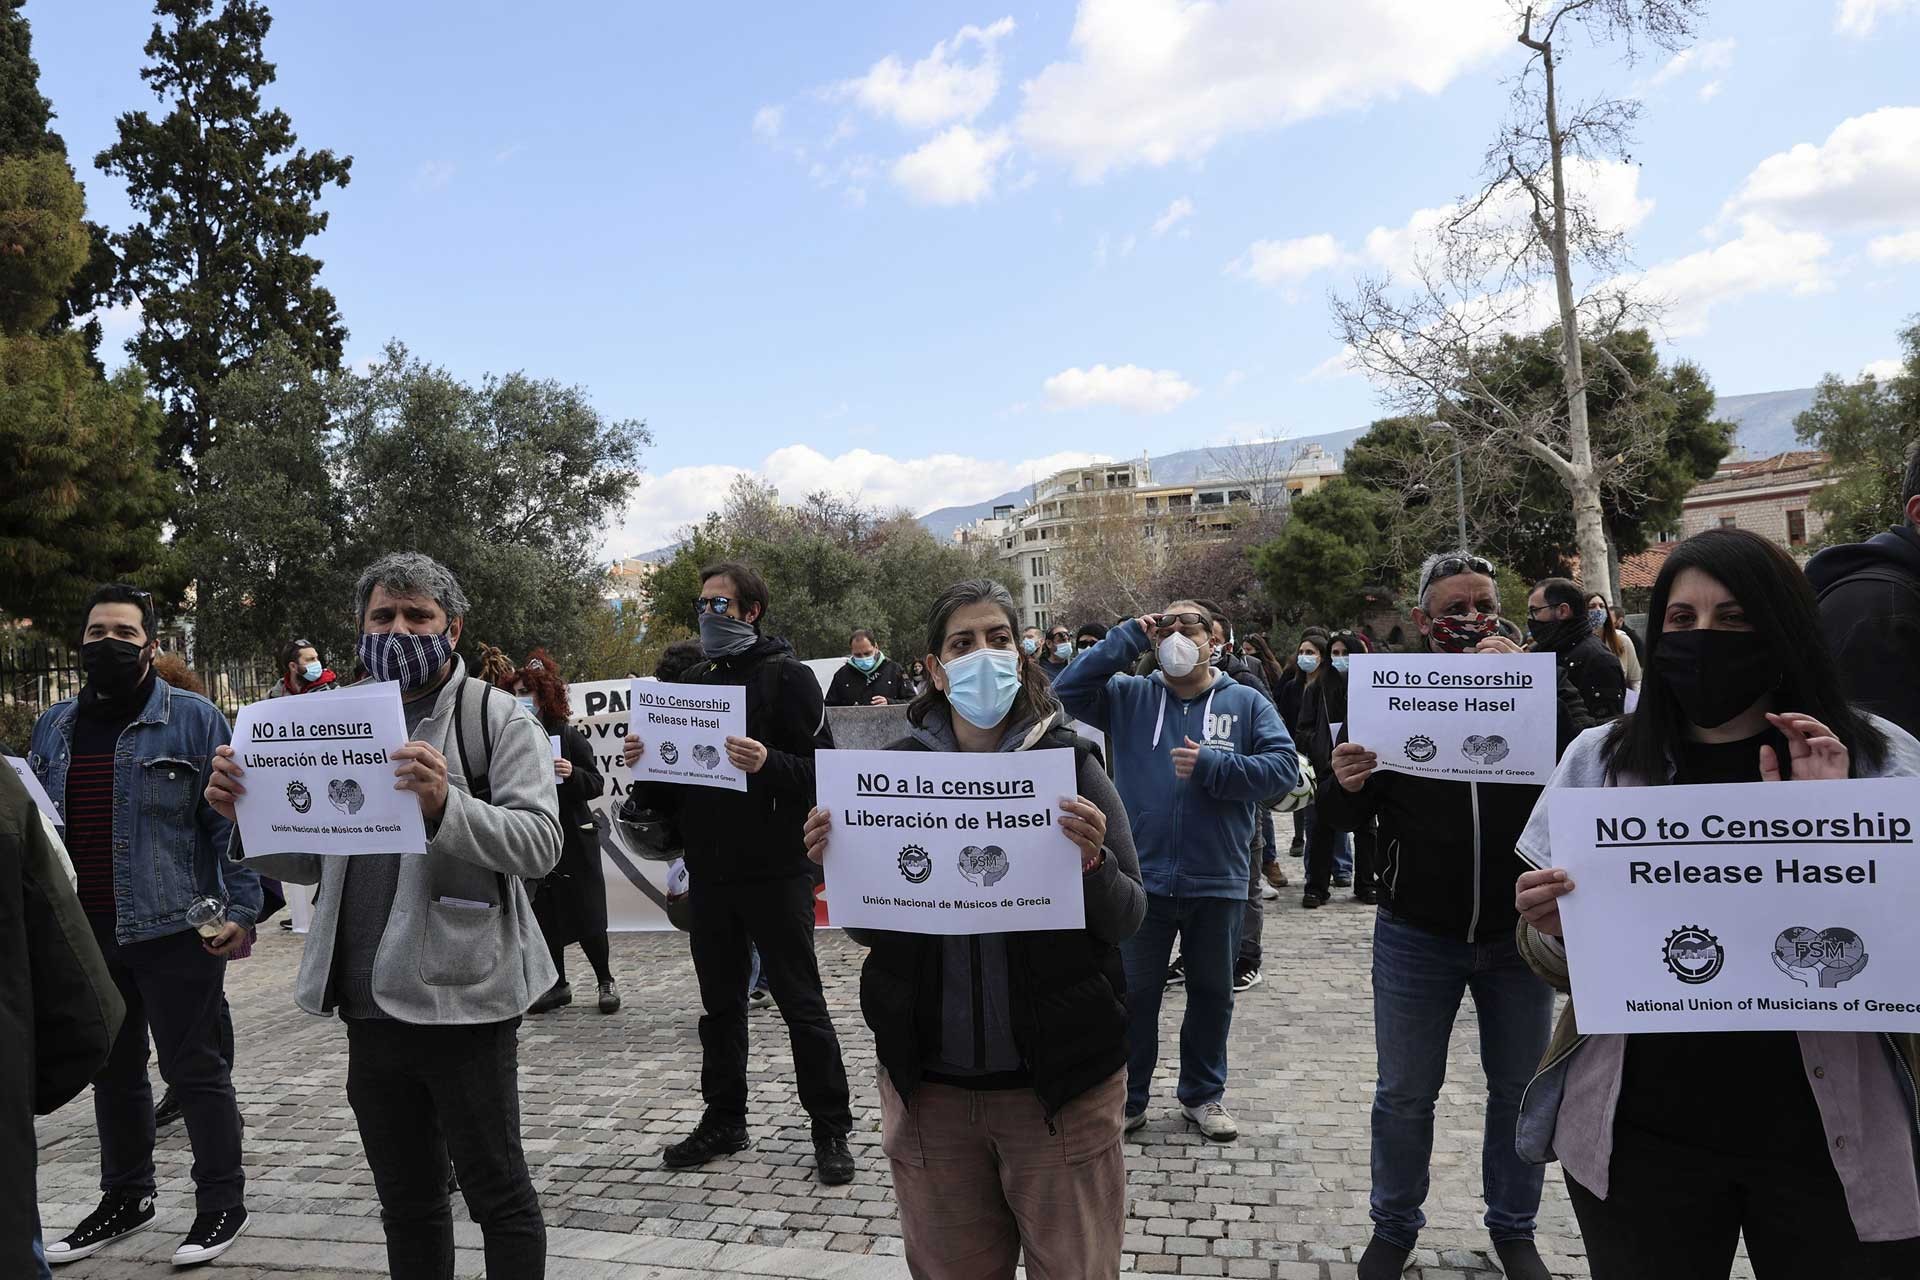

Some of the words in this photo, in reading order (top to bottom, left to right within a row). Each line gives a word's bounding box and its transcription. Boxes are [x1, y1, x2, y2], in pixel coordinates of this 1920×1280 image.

[1373, 671, 1399, 684] NO
[1405, 672, 1421, 685] to
[1428, 671, 1533, 688] Censorship
[640, 693, 653, 704] NO
[656, 696, 665, 705] to
[668, 696, 730, 712] Censorship
[1389, 697, 1458, 711] Release
[1465, 698, 1515, 711] Hasel
[648, 713, 687, 726] Release
[691, 716, 719, 728] Hasel
[252, 722, 274, 738] NO
[279, 727, 287, 738] a
[292, 722, 305, 737] la
[310, 722, 372, 737] censura
[244, 752, 317, 768] Liberación
[321, 752, 338, 766] de
[342, 749, 388, 765] Hasel
[1382, 761, 1414, 770] National
[857, 773, 890, 792] NO
[897, 779, 908, 793] a
[916, 776, 934, 794] la
[942, 779, 1034, 795] censura
[845, 810, 948, 828] Liberación
[955, 813, 979, 829] de
[986, 809, 1051, 828] Hasel
[1596, 817, 1646, 842] NO
[1657, 817, 1689, 840] to
[1701, 812, 1911, 842] Censorship
[292, 825, 320, 834] Nacional
[332, 825, 362, 834] Músicos
[375, 824, 401, 832] Grecia
[970, 855, 998, 868] FSM
[1630, 861, 1763, 884] Release
[1776, 859, 1876, 883] Hasel
[862, 896, 891, 905] Unión
[894, 898, 936, 908] Nacional
[939, 900, 951, 909] de
[954, 899, 997, 909] Músicos
[1000, 898, 1014, 907] de
[1016, 897, 1051, 907] Grecia
[1794, 942, 1845, 959] FSM
[1626, 999, 1684, 1013] National
[1688, 998, 1734, 1011] Union
[1738, 998, 1753, 1010] of
[1757, 998, 1838, 1011] Musicians
[1843, 999, 1860, 1012] of
